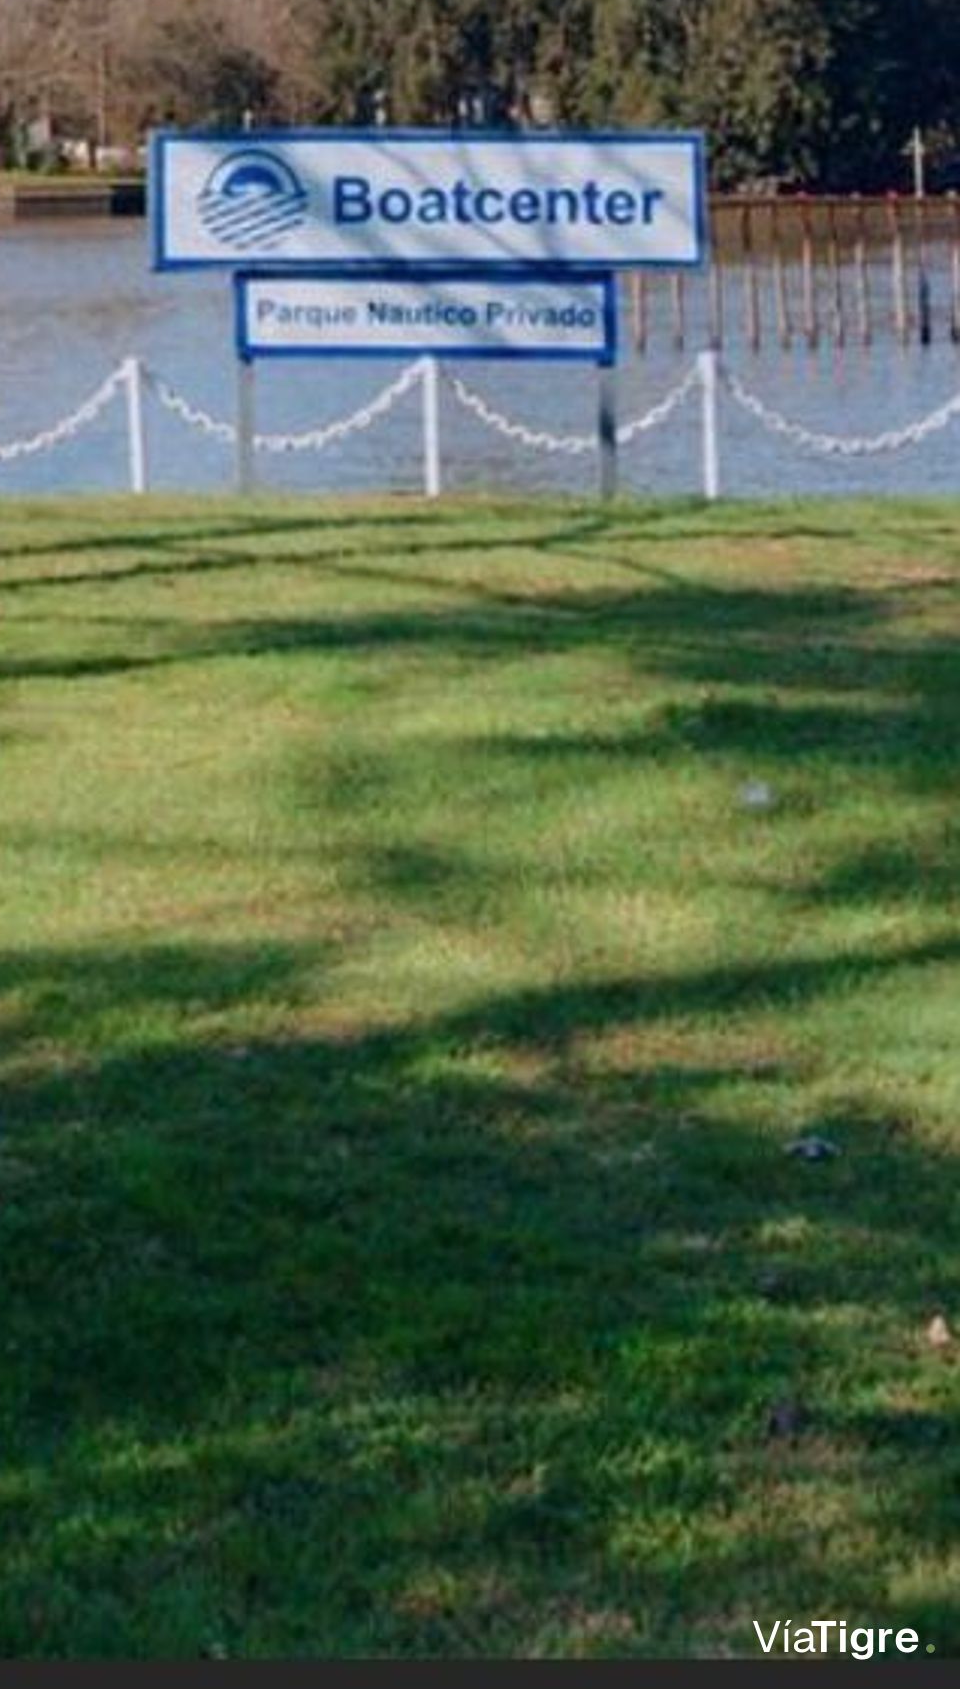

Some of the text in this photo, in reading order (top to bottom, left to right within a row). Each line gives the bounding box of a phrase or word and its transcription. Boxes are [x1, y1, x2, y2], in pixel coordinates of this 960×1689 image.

[333, 176, 663, 225] Boatcenter
[257, 299, 357, 328] Parque
[486, 302, 595, 327] Privado
